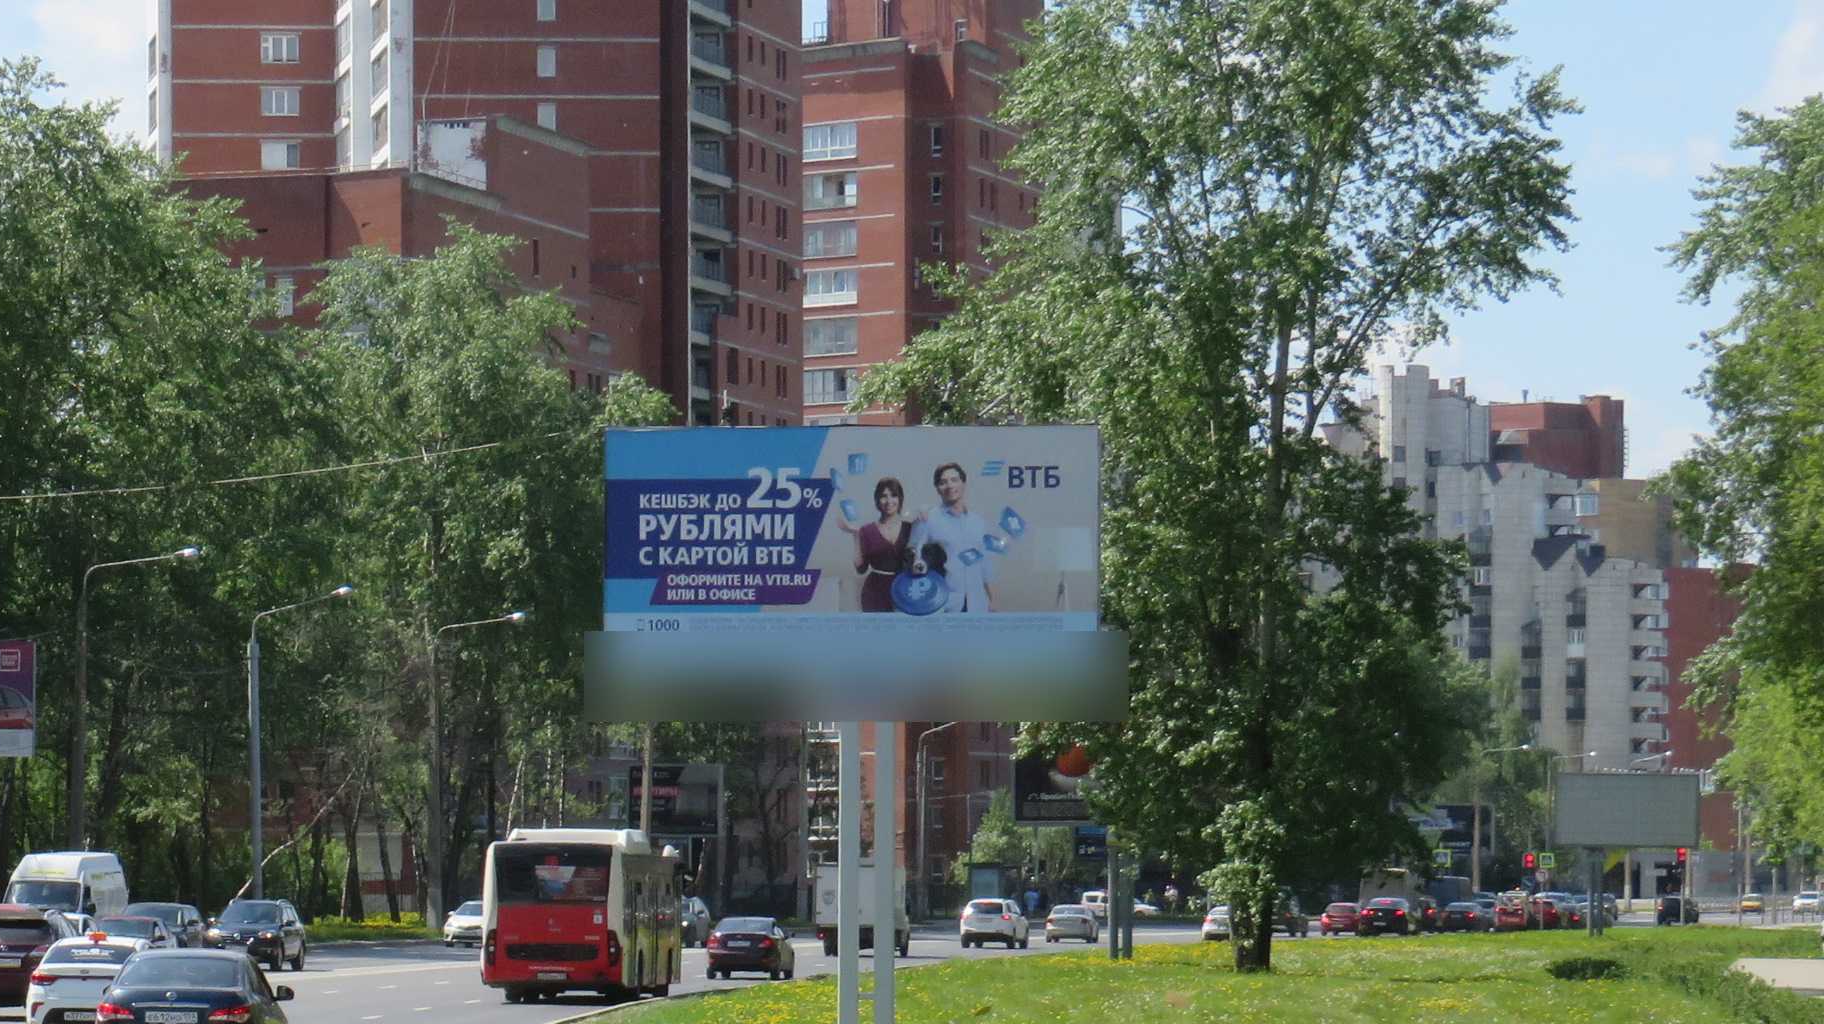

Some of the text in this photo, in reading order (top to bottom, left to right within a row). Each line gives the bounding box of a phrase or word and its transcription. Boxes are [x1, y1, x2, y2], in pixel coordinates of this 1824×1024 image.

[639, 466, 823, 511] КЕШБЭК ДО 25%
[1008, 465, 1061, 489] ВТБ
[639, 513, 795, 541] РУБЛЯМИ
[639, 541, 796, 565] С КАРТОЙ ВТБ
[667, 574, 812, 586] ОФОРМИТЕ НА VTB.RU
[667, 588, 756, 600] ИЛИ В ОФИСЕ
[648, 619, 680, 632] 1000
